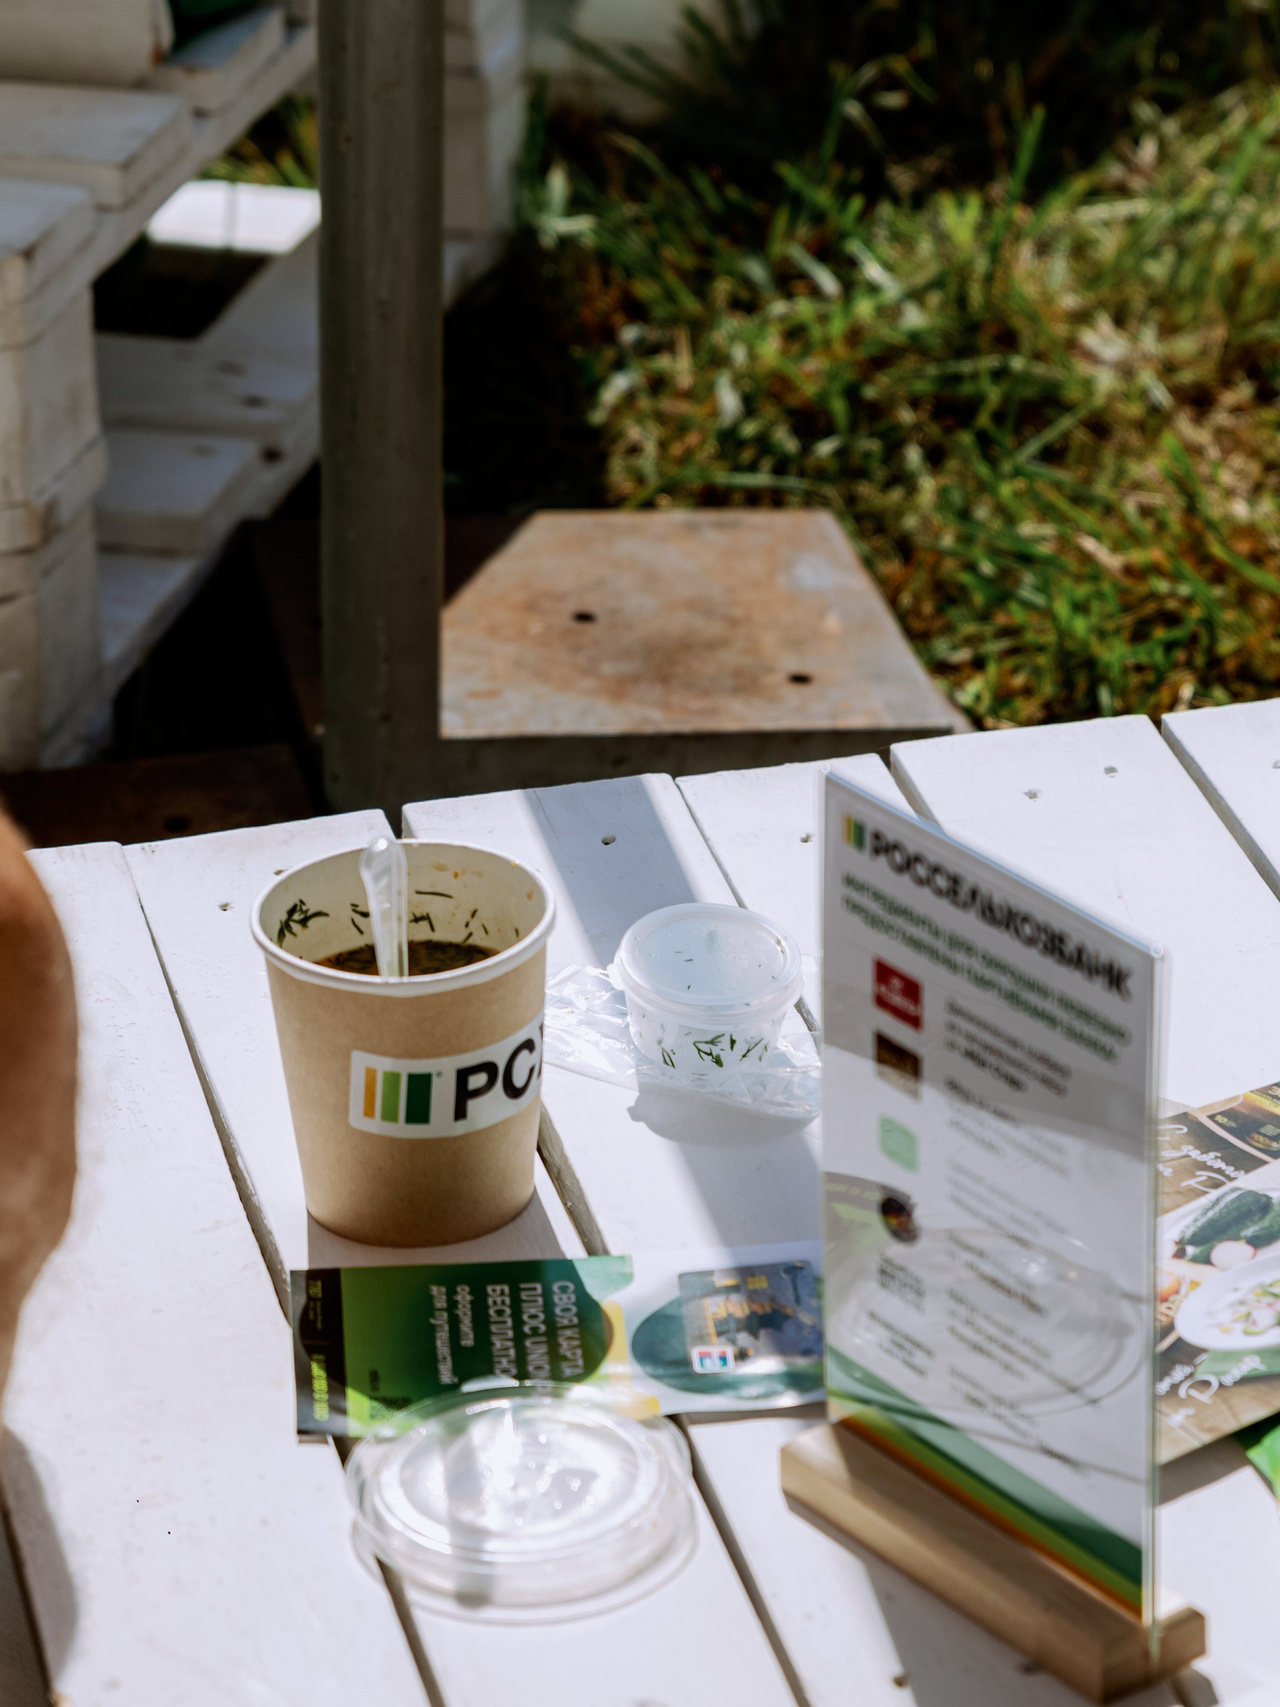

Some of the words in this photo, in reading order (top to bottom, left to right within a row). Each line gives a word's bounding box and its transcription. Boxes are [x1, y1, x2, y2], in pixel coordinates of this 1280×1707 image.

[868, 829, 1134, 1001] РОССЕЛЬХОЗБАНК
[453, 1025, 544, 1123] РС
[429, 1285, 448, 1309] для
[519, 1282, 547, 1335] ПЛЮС
[552, 1280, 580, 1327] СВОЯ
[556, 1327, 585, 1378] КАРТА
